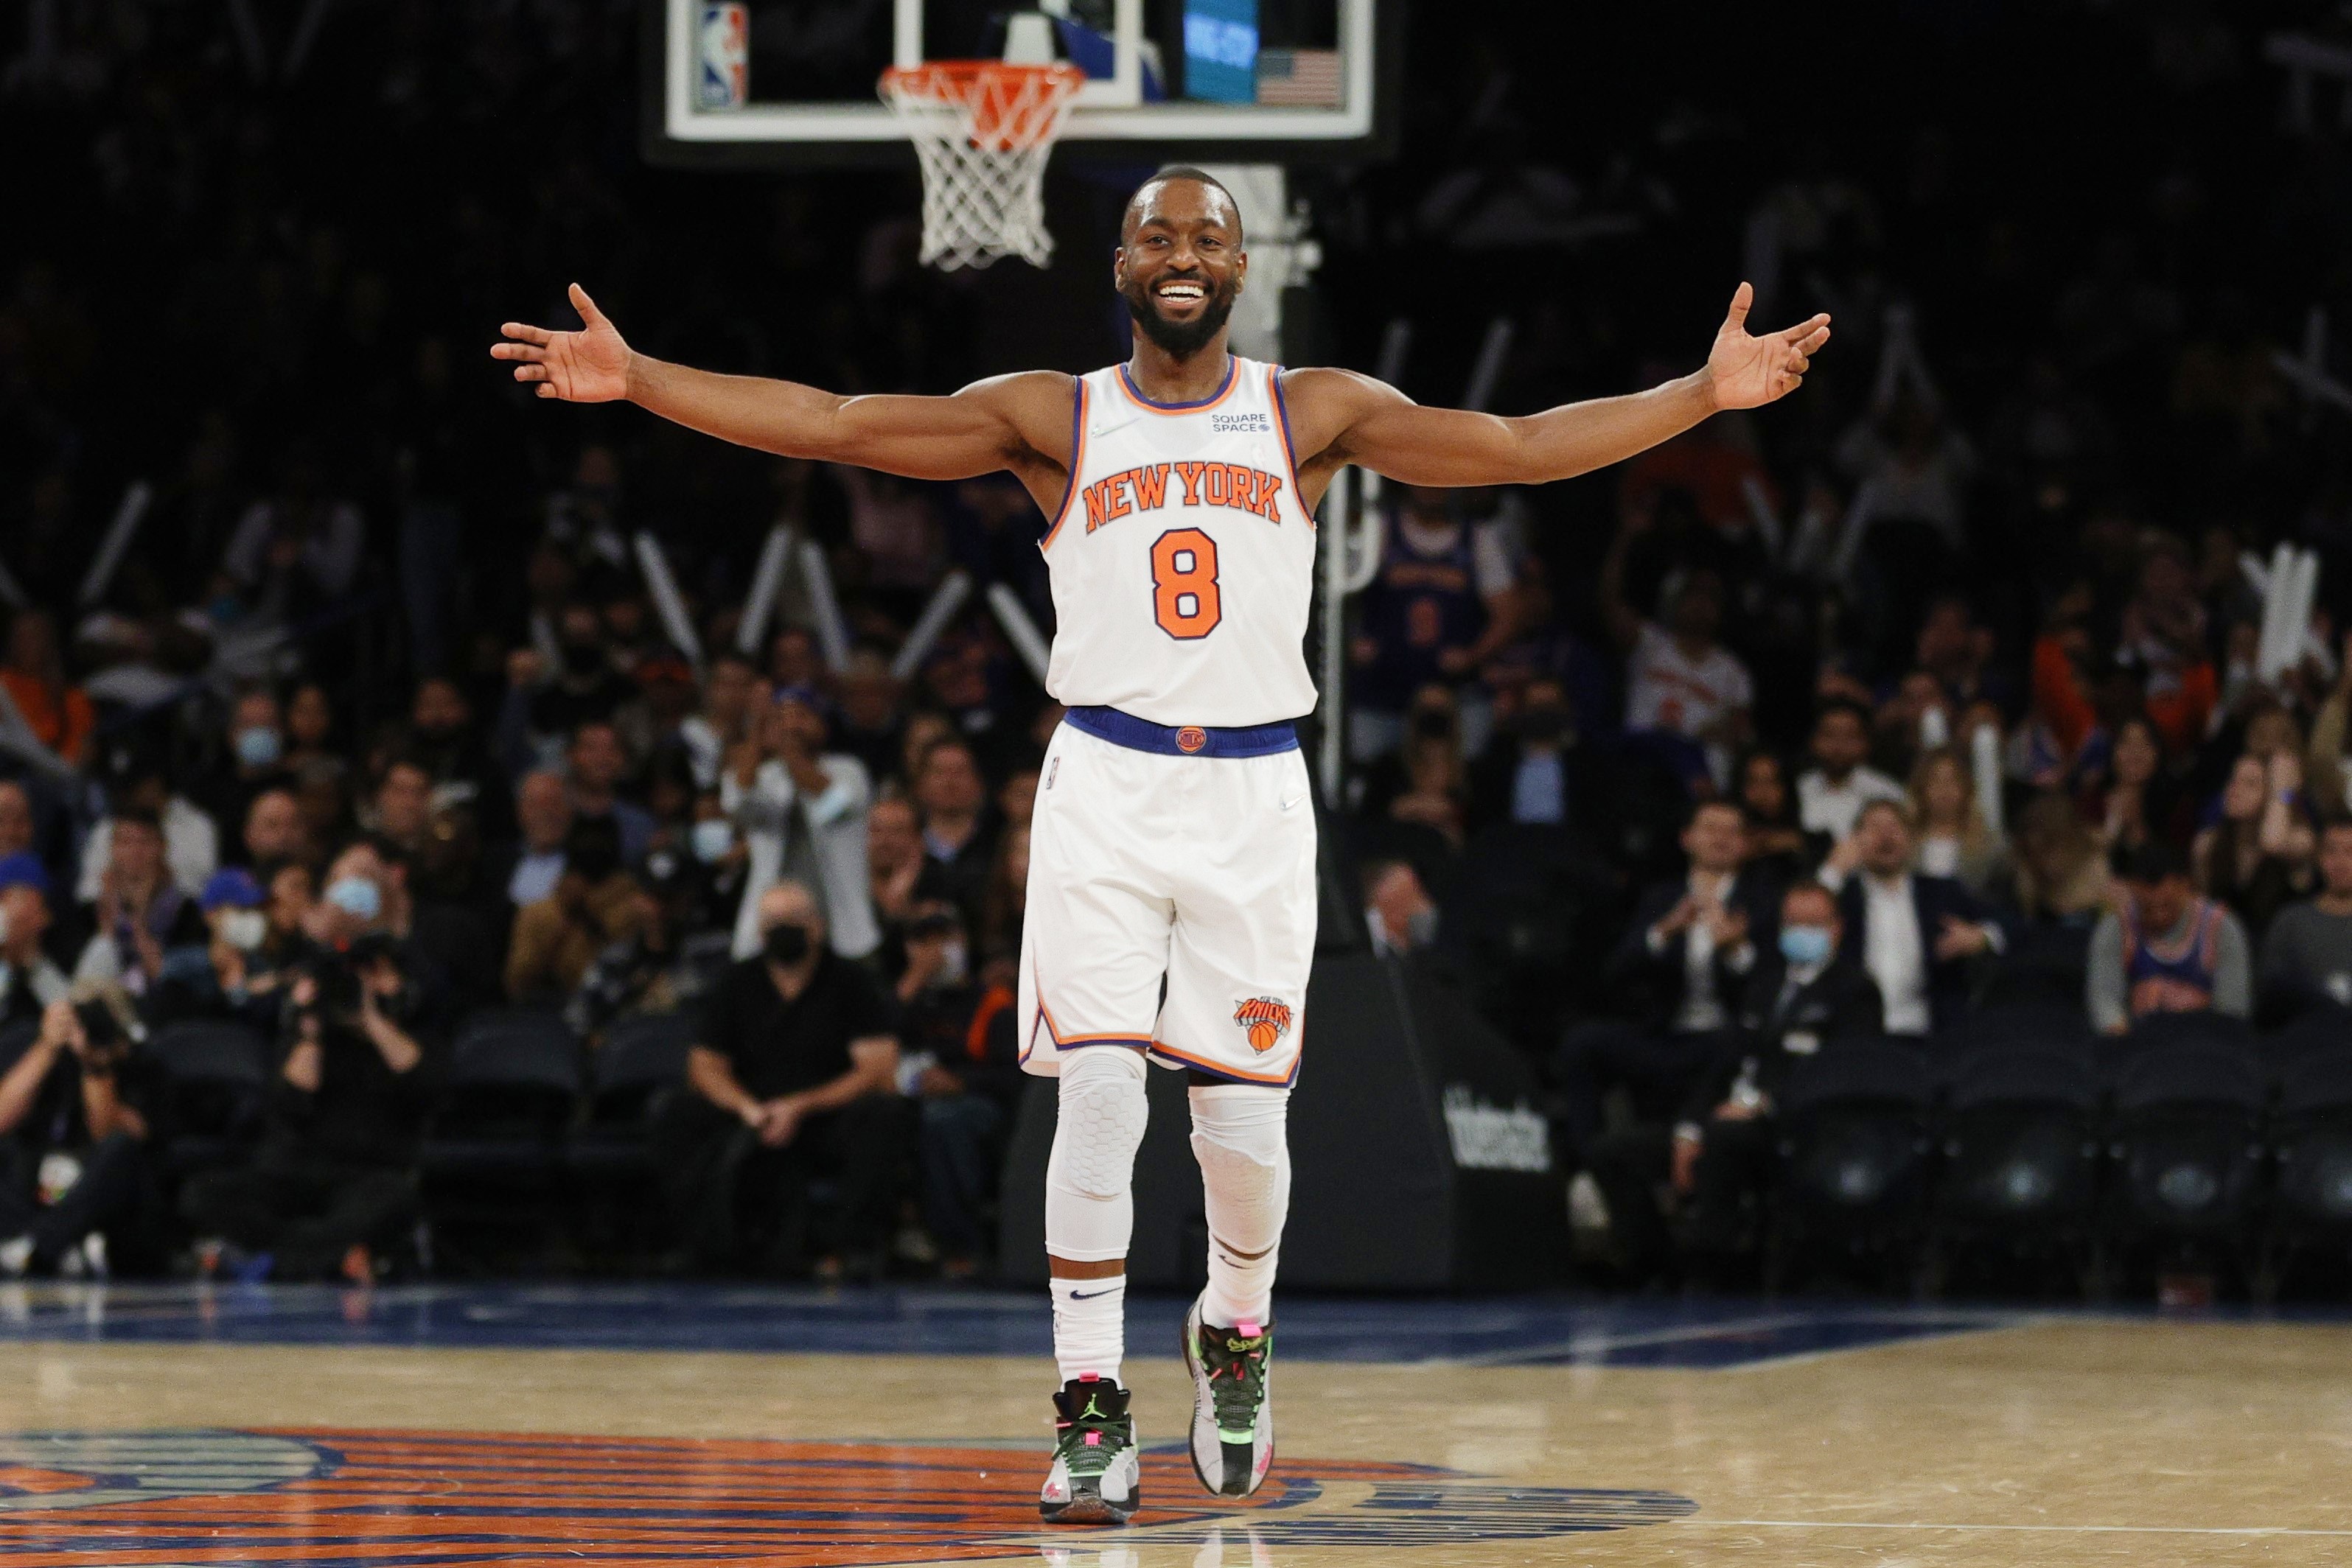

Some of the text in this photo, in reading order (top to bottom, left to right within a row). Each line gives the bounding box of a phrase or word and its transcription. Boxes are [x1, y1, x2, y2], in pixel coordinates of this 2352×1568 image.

[1212, 413, 1266, 423] SQUARE
[1213, 424, 1257, 433] SPACE
[1082, 461, 1282, 535] NEW YORK
[1149, 527, 1222, 641] 8
[1233, 998, 1291, 1031] KNICKS
